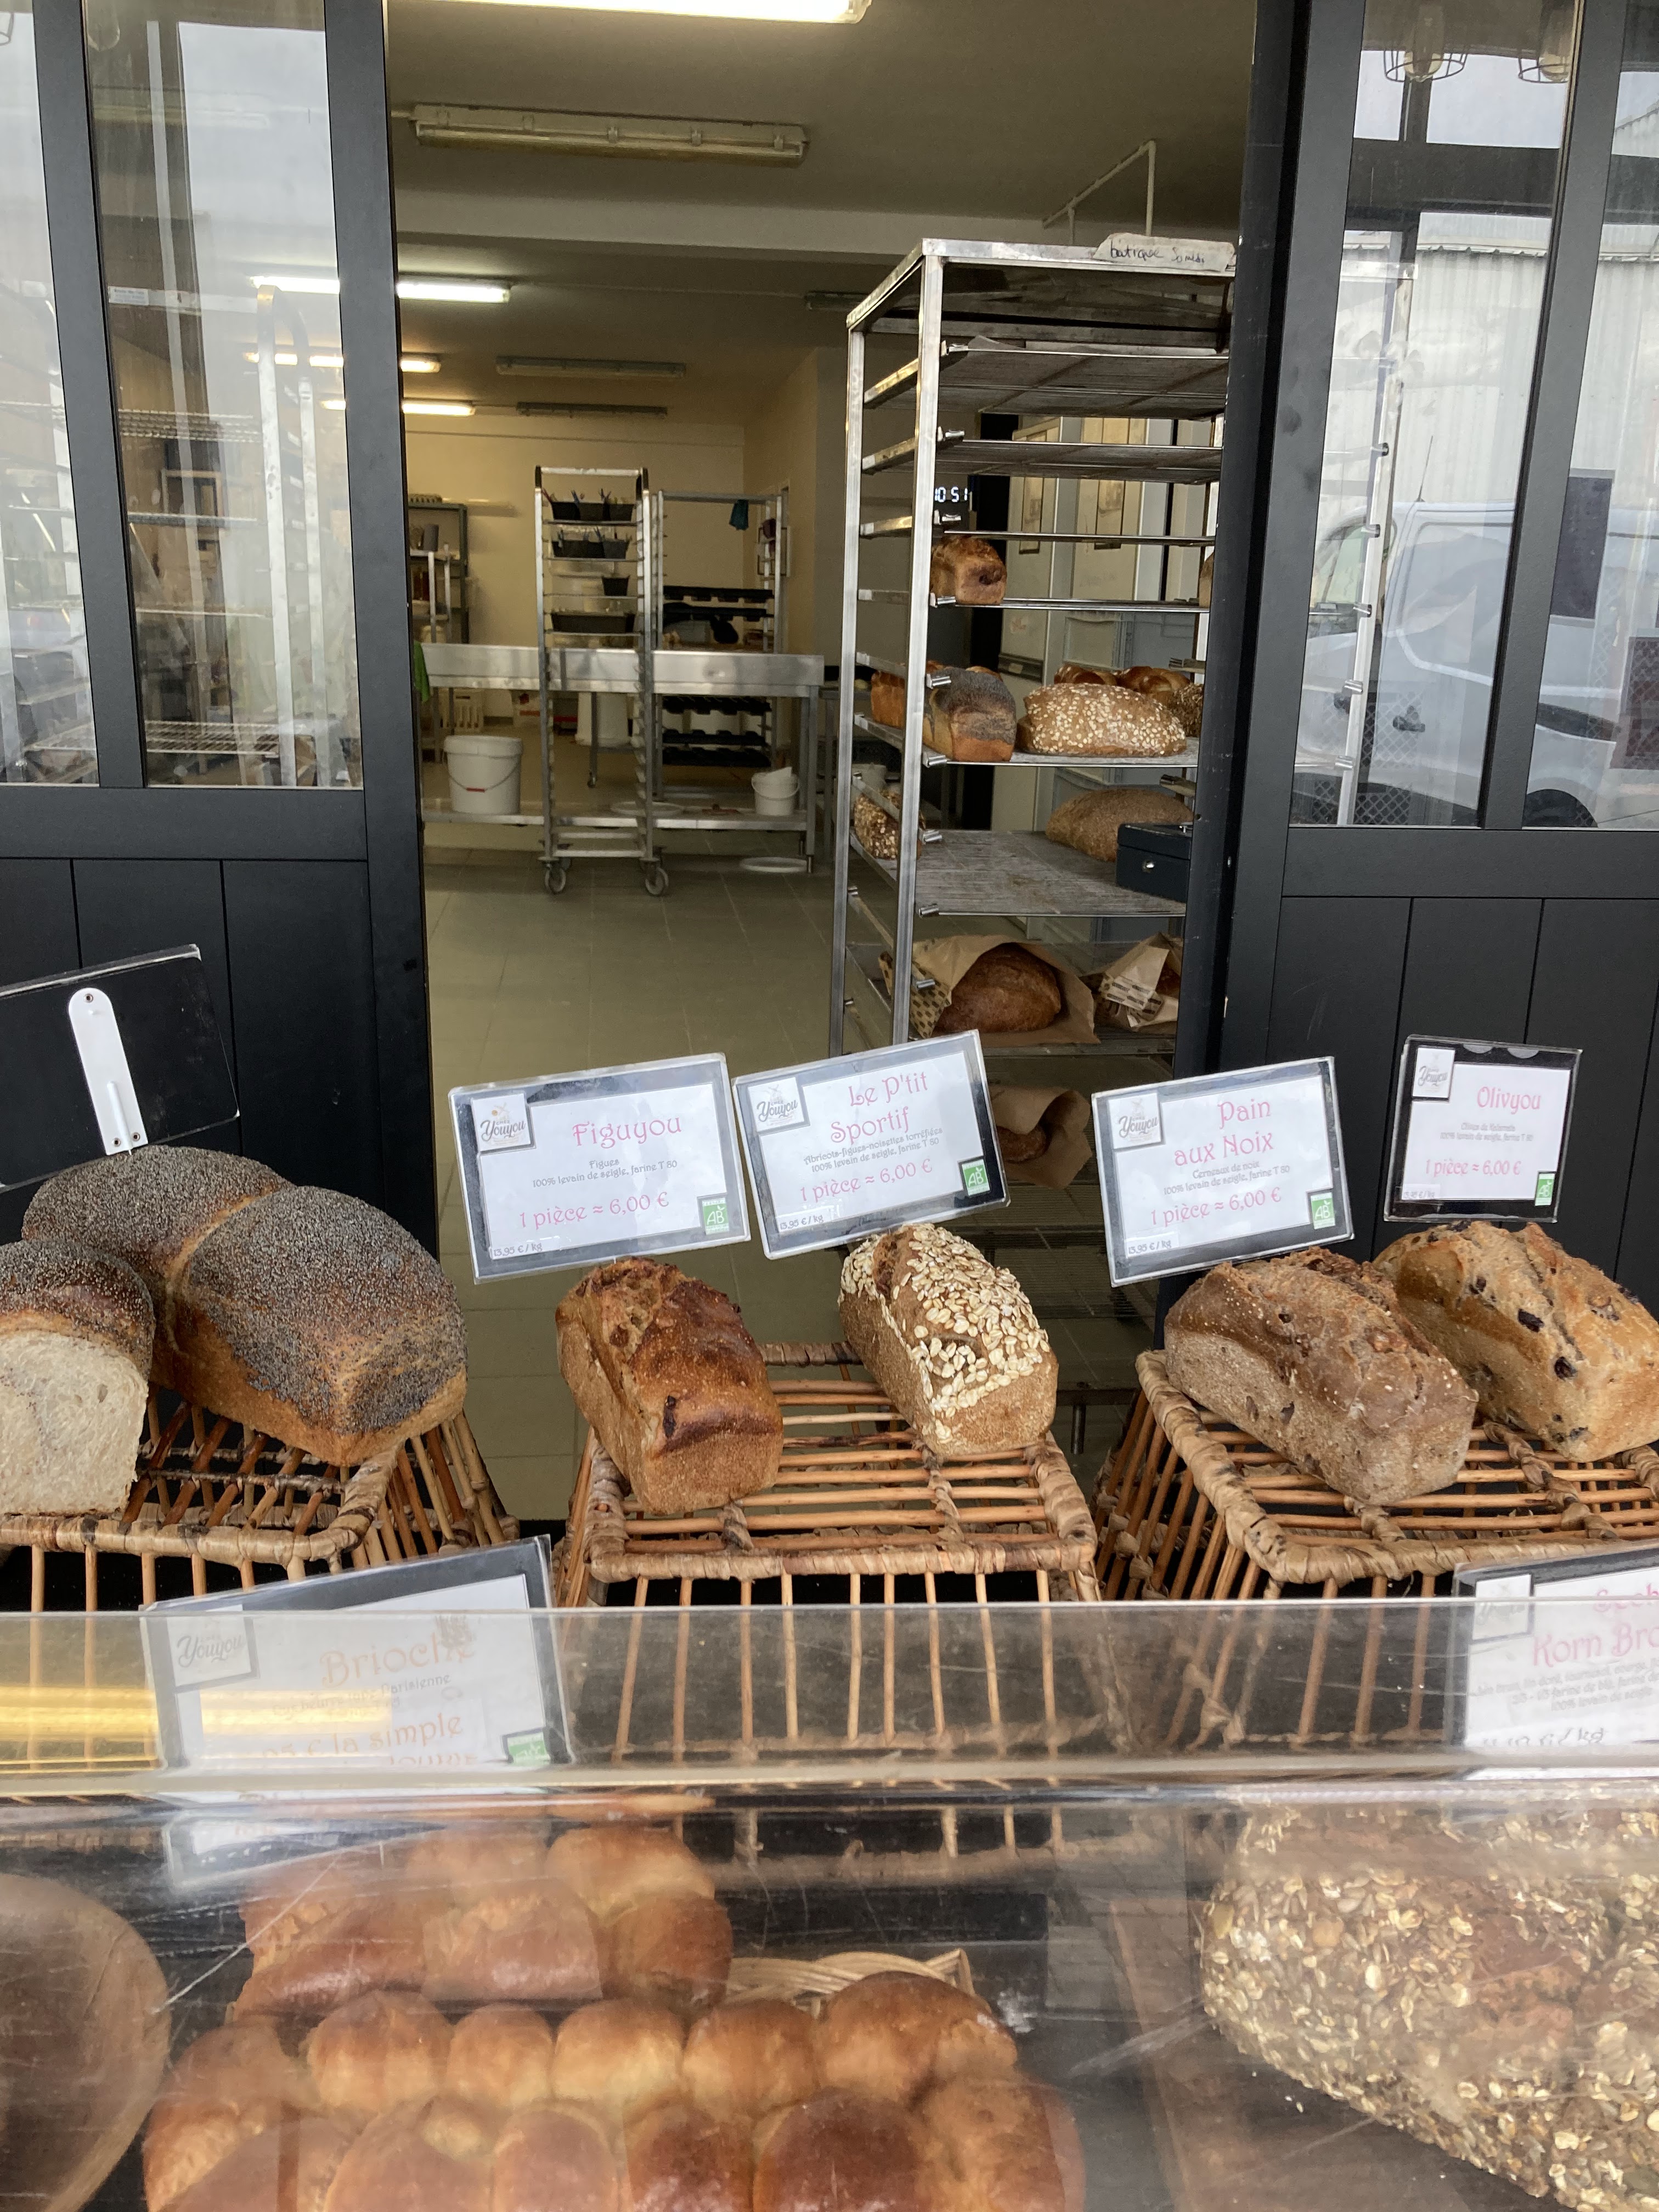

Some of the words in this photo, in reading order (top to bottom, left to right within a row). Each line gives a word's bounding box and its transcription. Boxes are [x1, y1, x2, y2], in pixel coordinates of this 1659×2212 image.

[848, 1085, 878, 1107] Le
[882, 1071, 929, 1104] P'tit
[1476, 1086, 1542, 1115] Olivyou
[757, 1099, 798, 1122] Youyou
[1217, 1097, 1272, 1129] Pain
[479, 1120, 527, 1142] Youyou
[572, 1117, 681, 1149] Figuyou
[830, 1105, 910, 1145] Sportif
[1118, 1115, 1158, 1138] Youyou
[812, 1161, 833, 1173] 100%
[833, 1156, 859, 1169] levain
[860, 1153, 871, 1163] de
[898, 1142, 922, 1155] farine
[921, 1139, 928, 1148] T
[929, 1137, 940, 1147] 80
[1173, 1142, 1216, 1166] aux
[1222, 1132, 1274, 1159] Noix
[533, 1177, 556, 1188] 100%
[558, 1173, 585, 1186] levain
[587, 1171, 599, 1181] de
[600, 1167, 629, 1178] seigle,
[631, 1163, 657, 1176] farine
[657, 1161, 664, 1170] T
[666, 1160, 678, 1169] 80
[589, 1159, 620, 1170] Figues
[1185, 1180, 1209, 1192] levain
[1211, 1177, 1221, 1187] de
[1249, 1169, 1272, 1182] farine
[1272, 1166, 1278, 1175] T
[1280, 1165, 1290, 1174] 80
[1231, 1163, 1242, 1173] de
[1425, 1159, 1430, 1175] 1
[1433, 1156, 1469, 1178] pièce
[1482, 1160, 1510, 1177] 6,00
[1513, 1160, 1522, 1175] €
[800, 1186, 809, 1202] 1
[812, 1175, 861, 1203] pièce
[879, 1160, 917, 1185] 6,00
[921, 1158, 934, 1174] €
[968, 1171, 984, 1187] AB
[519, 1211, 527, 1228] 1
[532, 1205, 588, 1230] pièce
[609, 1194, 651, 1215] 6,00
[656, 1191, 670, 1207] €
[707, 1210, 725, 1226] AB
[1152, 1209, 1157, 1225] 1
[1162, 1201, 1211, 1227] pièce
[1228, 1189, 1266, 1212] 6,00
[1270, 1186, 1282, 1203] €
[1314, 1205, 1330, 1220] AB
[531, 1242, 543, 1252] kg
[1533, 1633, 1601, 1667] Korn
[381, 1674, 452, 1694] Parisienne
[368, 1712, 463, 1752] simple
